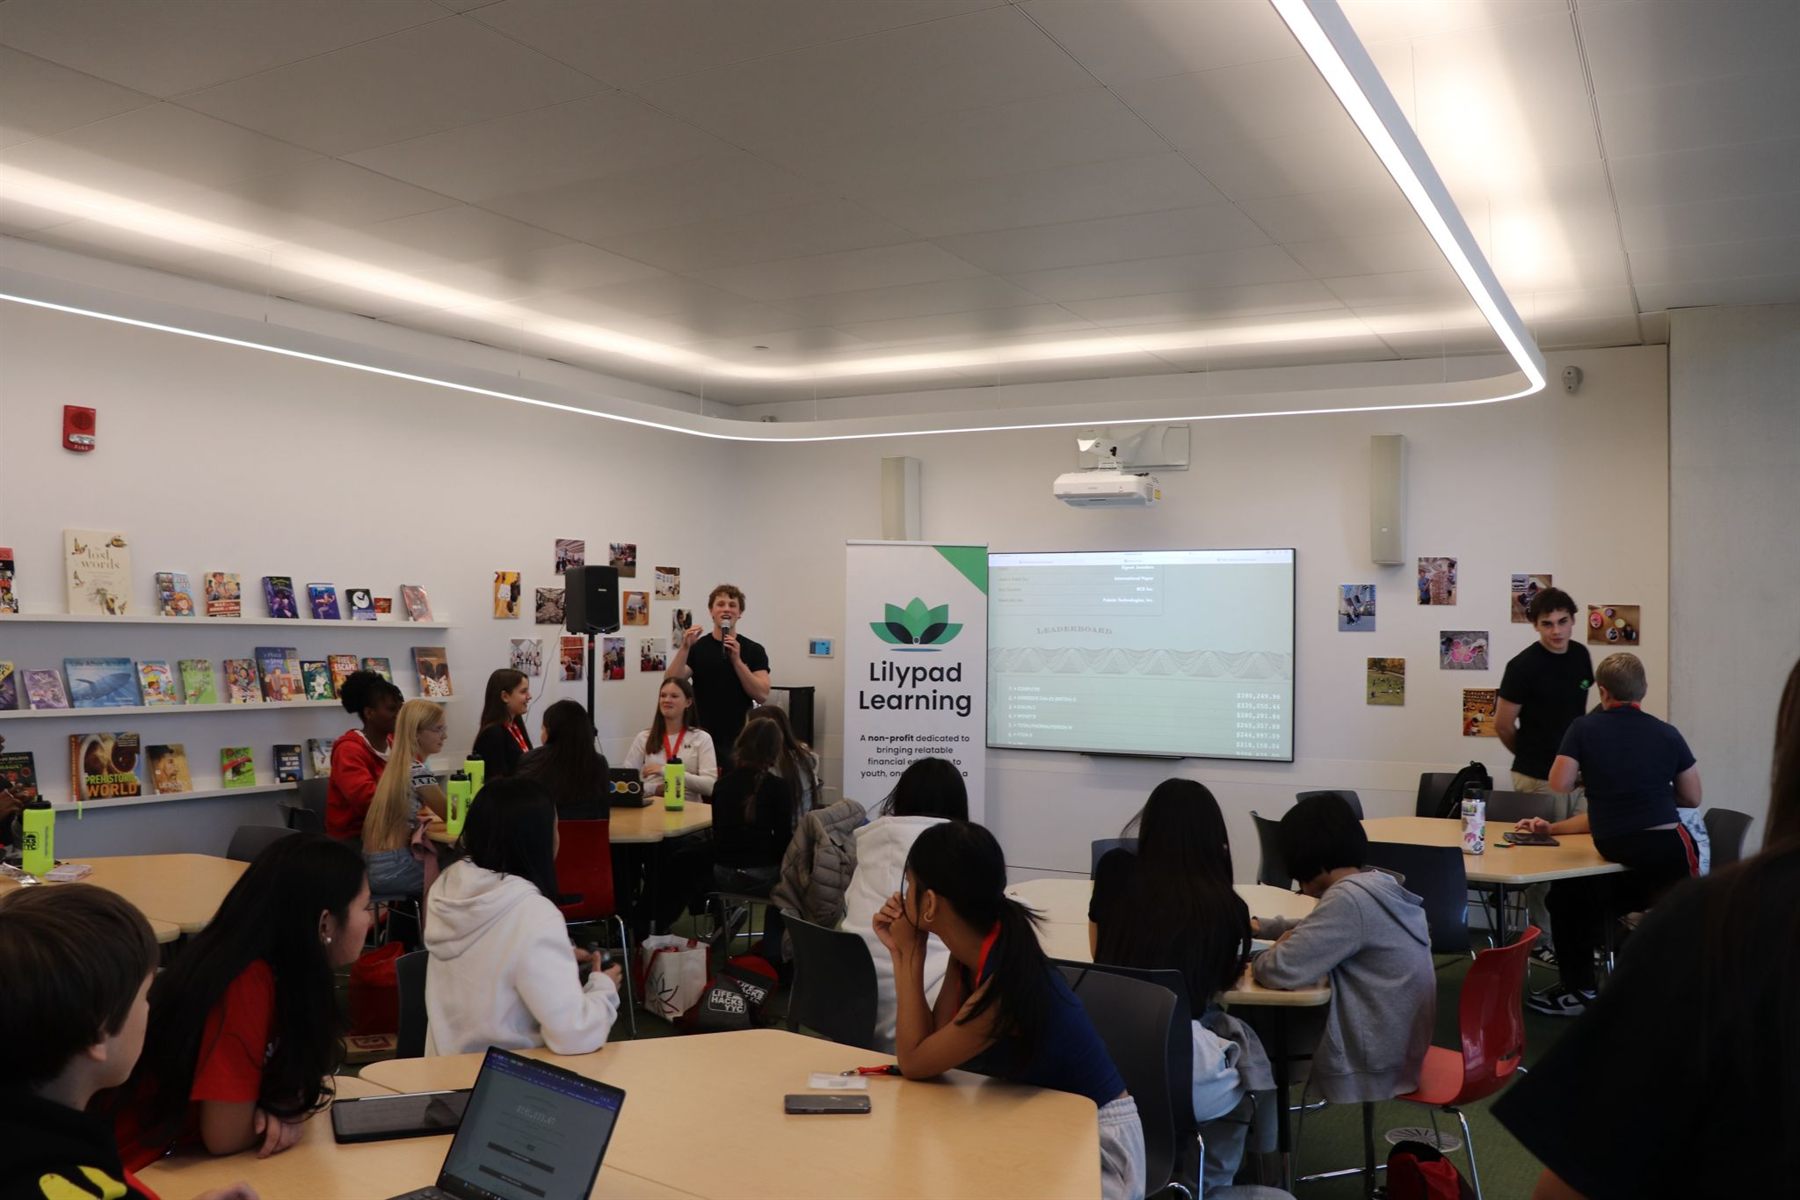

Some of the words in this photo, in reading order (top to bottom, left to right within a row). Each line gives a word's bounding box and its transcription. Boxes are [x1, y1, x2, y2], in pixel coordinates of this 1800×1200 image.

[1036, 625, 1113, 635] LEADERBOARD
[870, 660, 962, 688] Lilypad
[859, 689, 971, 717] Learning
[868, 734, 914, 744] non-profit
[877, 746, 913, 756] bringing
[914, 746, 953, 754] relatable
[868, 757, 905, 766] financial
[952, 758, 961, 766] to
[861, 770, 887, 779] youth,
[86, 782, 138, 797] WORLD
[712, 990, 732, 998] LIFE
[711, 996, 744, 1006] HACKS
[724, 1004, 744, 1013] YYC
